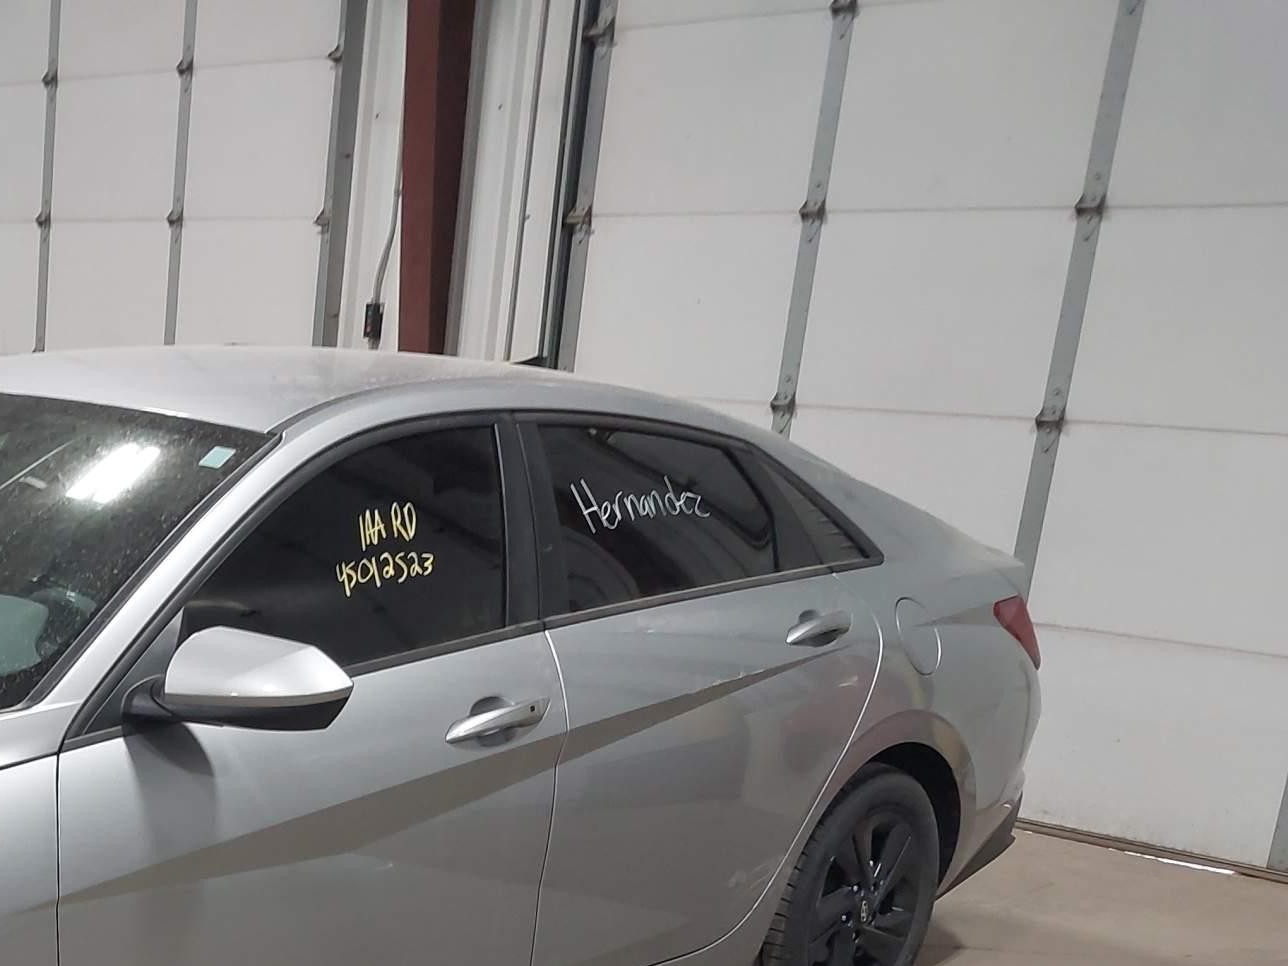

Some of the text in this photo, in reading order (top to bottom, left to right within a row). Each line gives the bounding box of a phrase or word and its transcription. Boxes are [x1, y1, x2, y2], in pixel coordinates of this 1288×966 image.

[359, 501, 417, 552] IAA RD
[570, 474, 711, 534] Hernandez
[335, 551, 434, 598] 45012523
